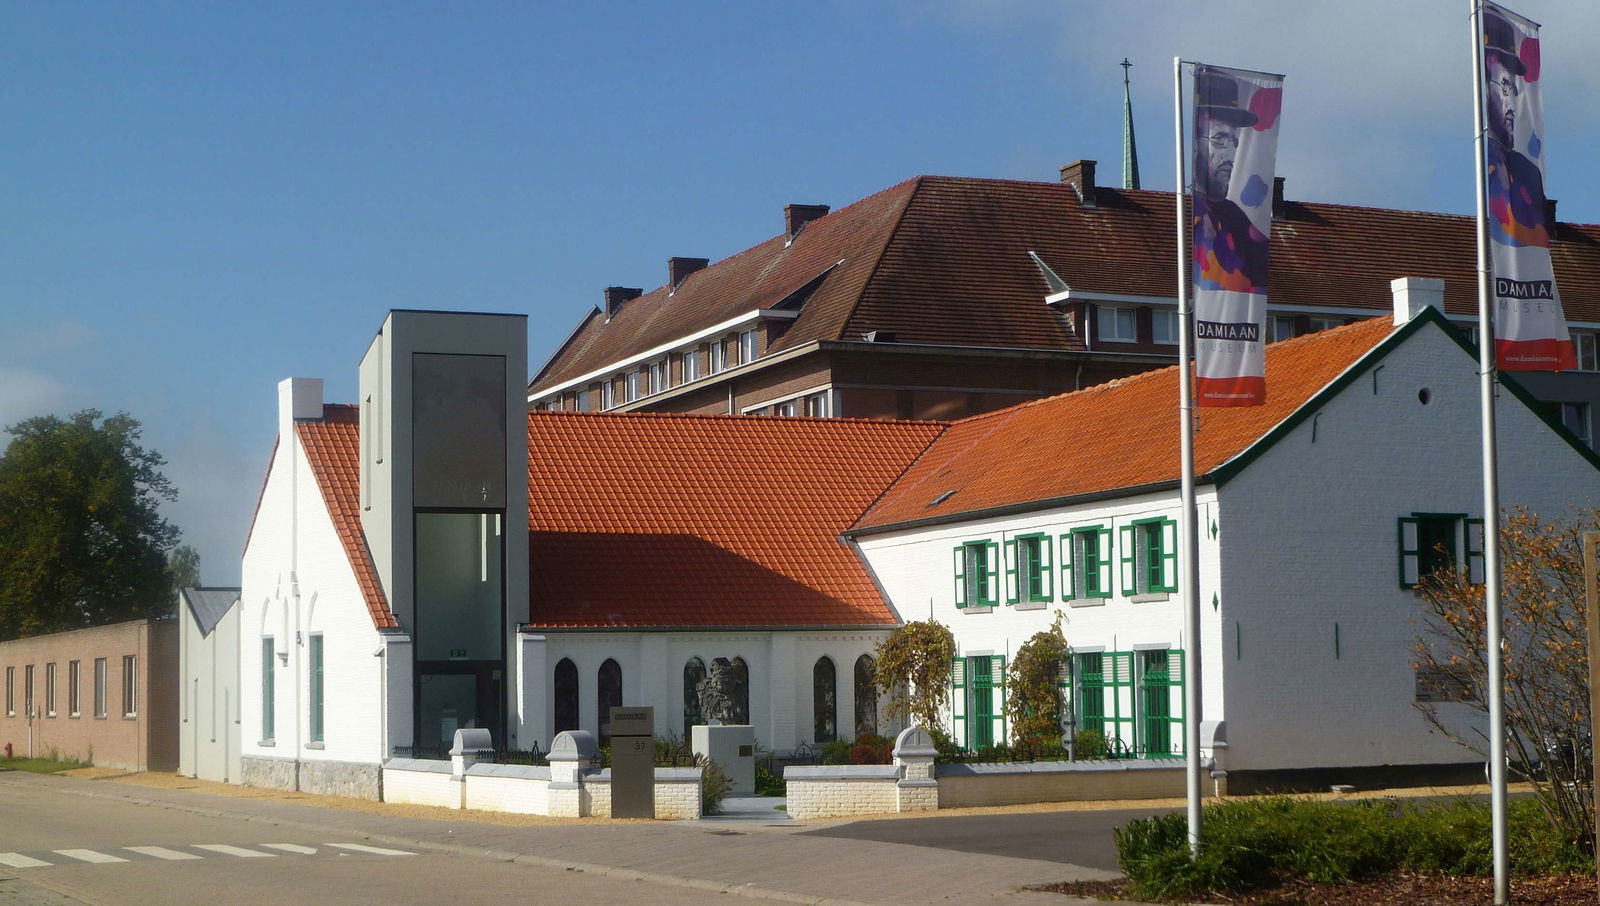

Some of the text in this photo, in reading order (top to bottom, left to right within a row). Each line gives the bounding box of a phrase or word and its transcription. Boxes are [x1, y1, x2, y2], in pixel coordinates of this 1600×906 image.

[1199, 323, 1256, 339] DAMIAAN
[1199, 342, 1257, 354] MUSEUM
[634, 742, 646, 750] 37
